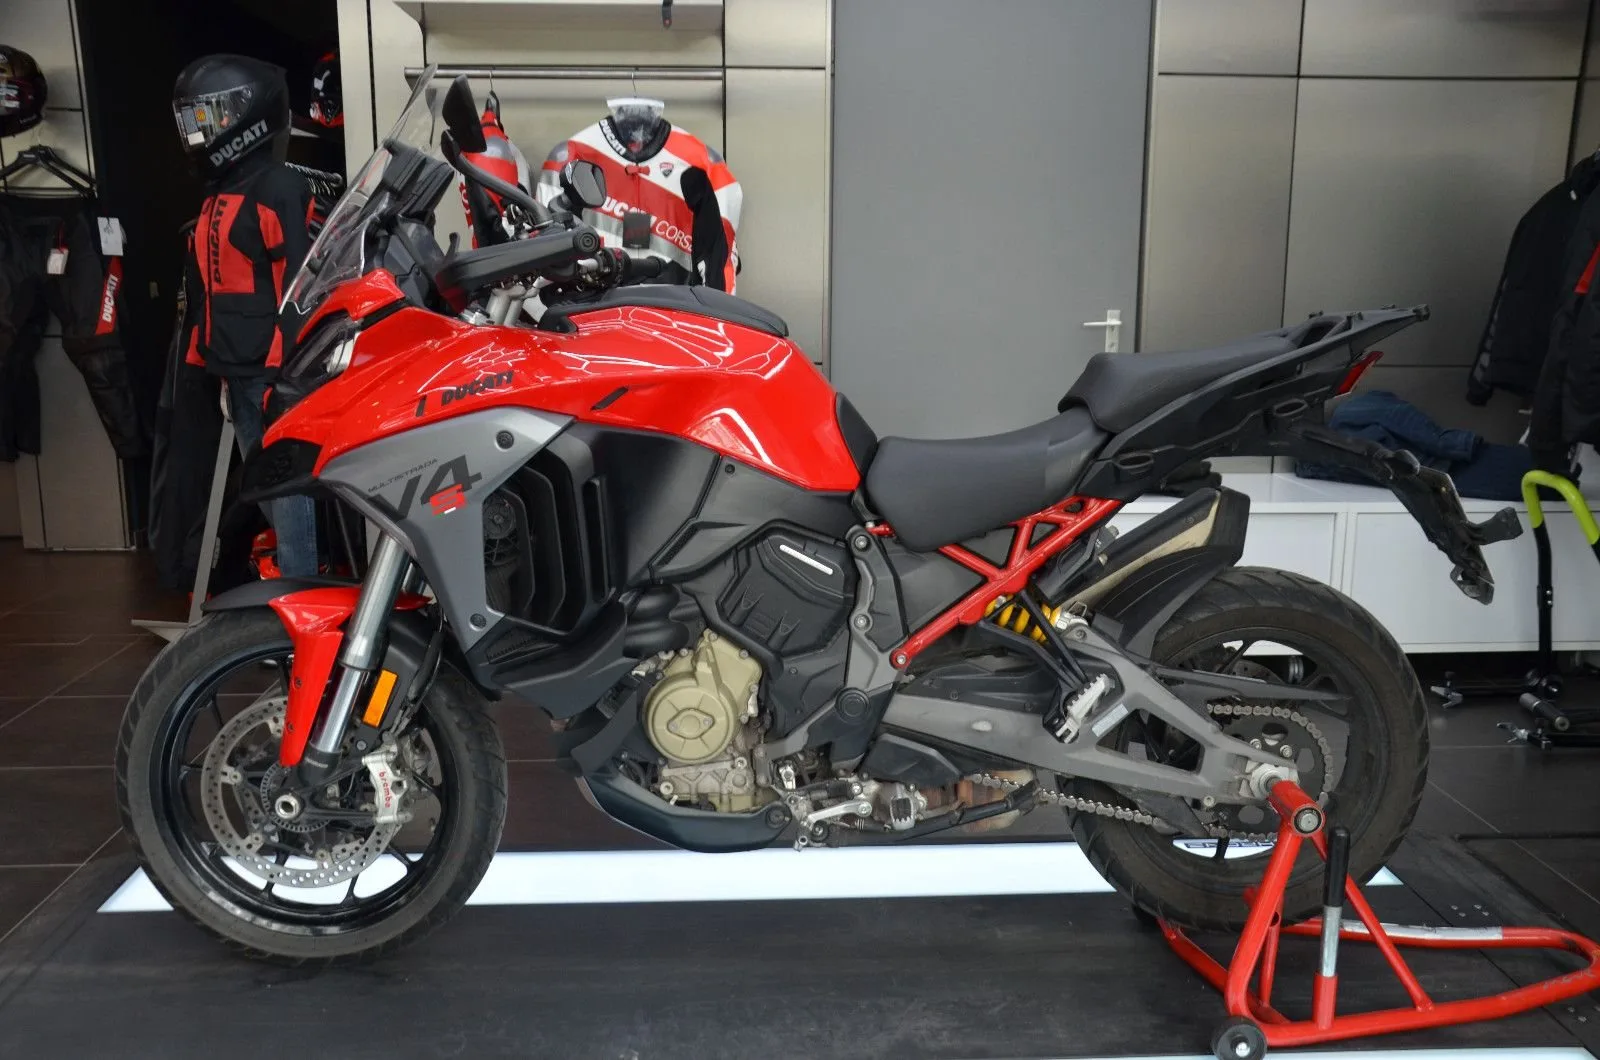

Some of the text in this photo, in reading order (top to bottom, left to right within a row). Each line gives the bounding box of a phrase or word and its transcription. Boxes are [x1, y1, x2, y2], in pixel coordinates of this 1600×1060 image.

[210, 119, 268, 167] DUCATI
[600, 119, 627, 155] DUCATI
[210, 199, 228, 285] DUCATI
[655, 220, 692, 252] CORS
[102, 274, 118, 323] DUCATI
[441, 371, 514, 406] DUCATI
[368, 458, 438, 493] MULTISTRADA
[379, 770, 392, 808] brembo
